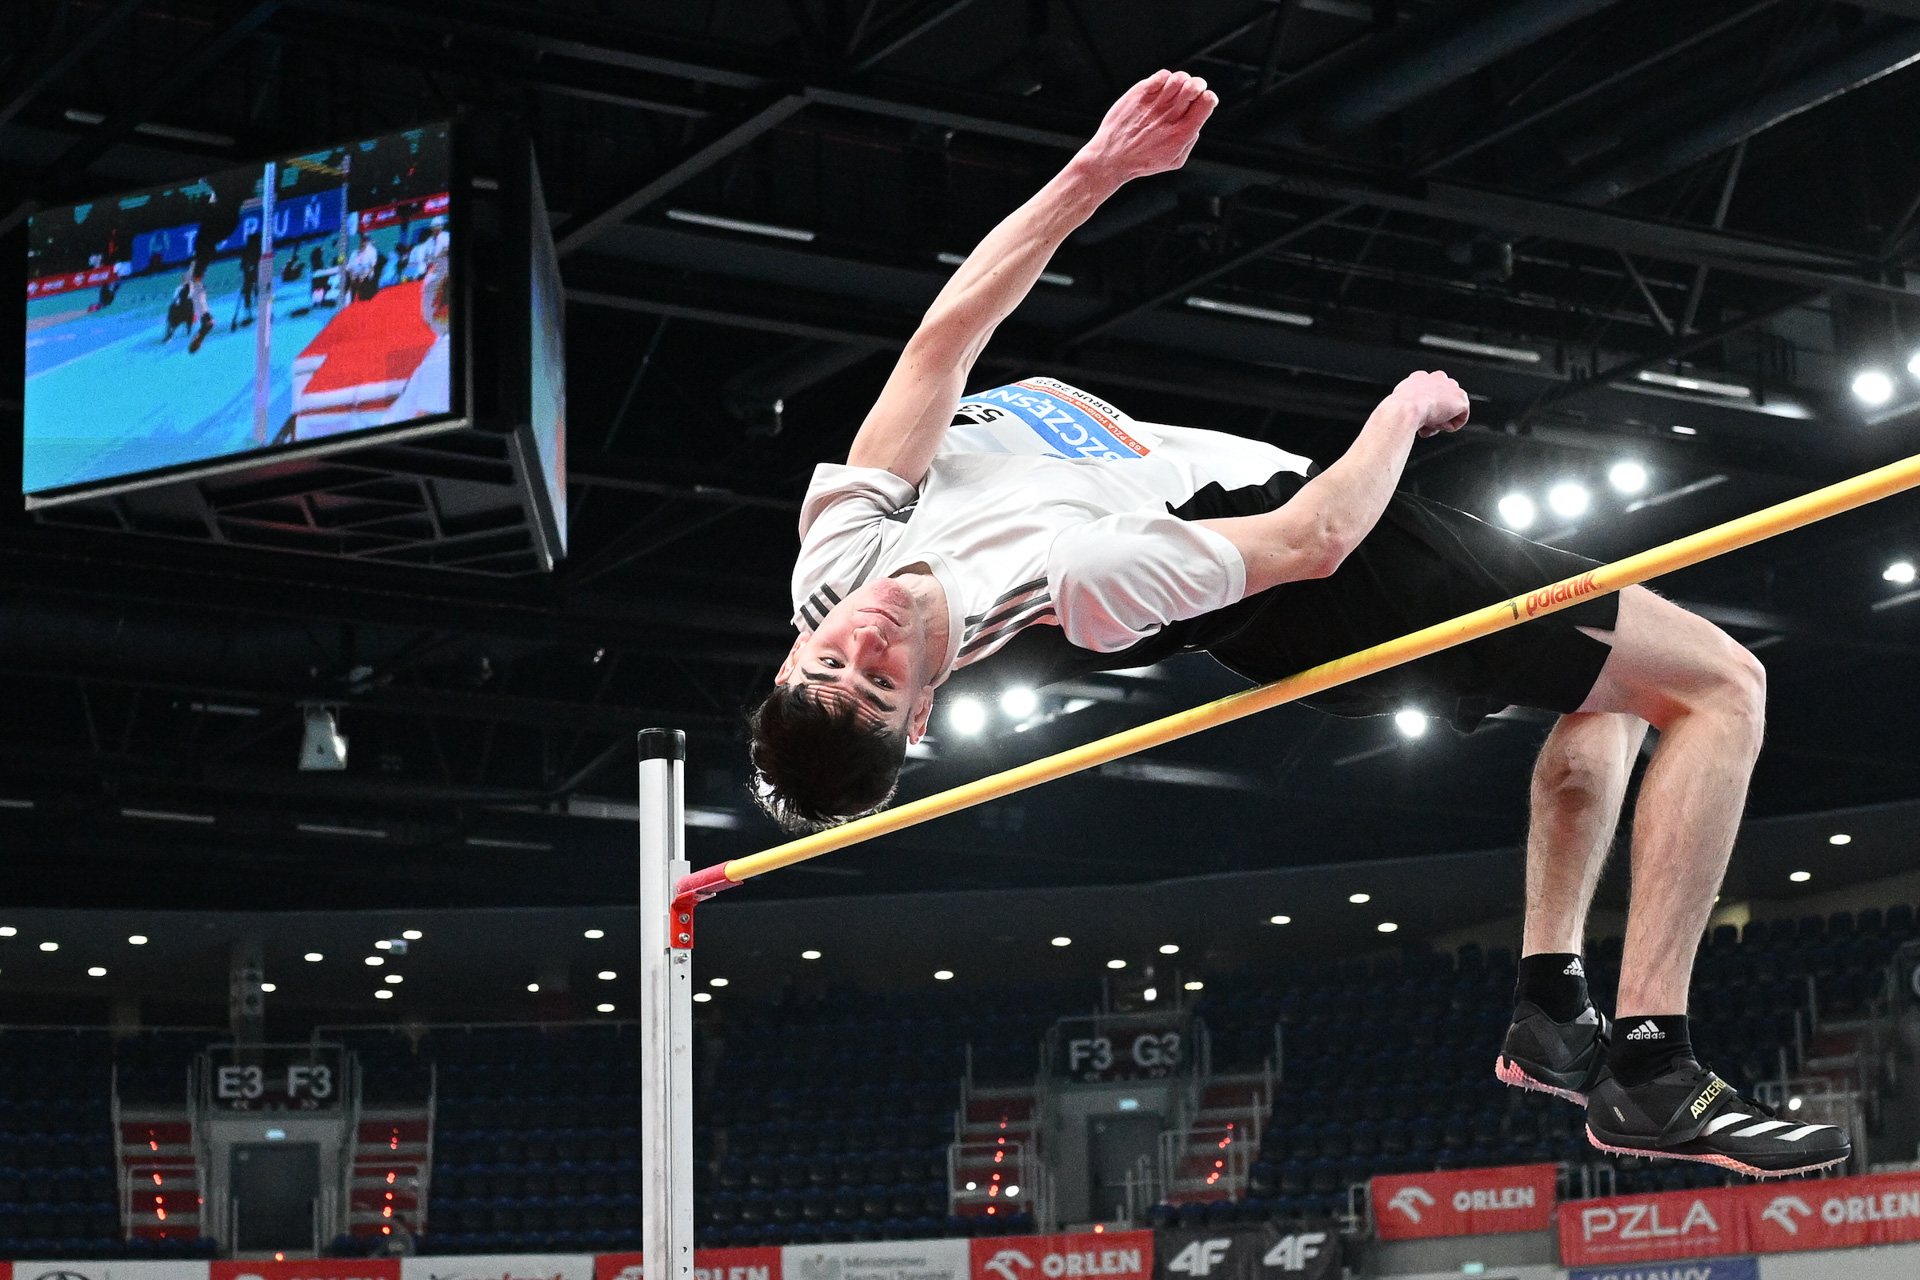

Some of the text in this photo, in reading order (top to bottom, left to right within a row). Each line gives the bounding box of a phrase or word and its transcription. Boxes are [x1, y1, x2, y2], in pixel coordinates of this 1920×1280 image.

[1075, 400, 1108, 424] Halowe
[1107, 422, 1128, 441] PZLA
[1526, 571, 1598, 617] polanik
[1069, 1032, 1182, 1071] F3 G3
[1626, 1030, 1666, 1041] adidas
[217, 1065, 332, 1099] E3 F3
[1452, 1186, 1536, 1213] ORLEN
[1821, 1191, 1920, 1226] ORLEN
[1581, 1199, 1720, 1243] PZLA
[1041, 1249, 1142, 1279] ORLEN
[1167, 1236, 1232, 1277] 4F
[1263, 1231, 1328, 1272] 4F
[694, 1265, 769, 1280] RLEN
